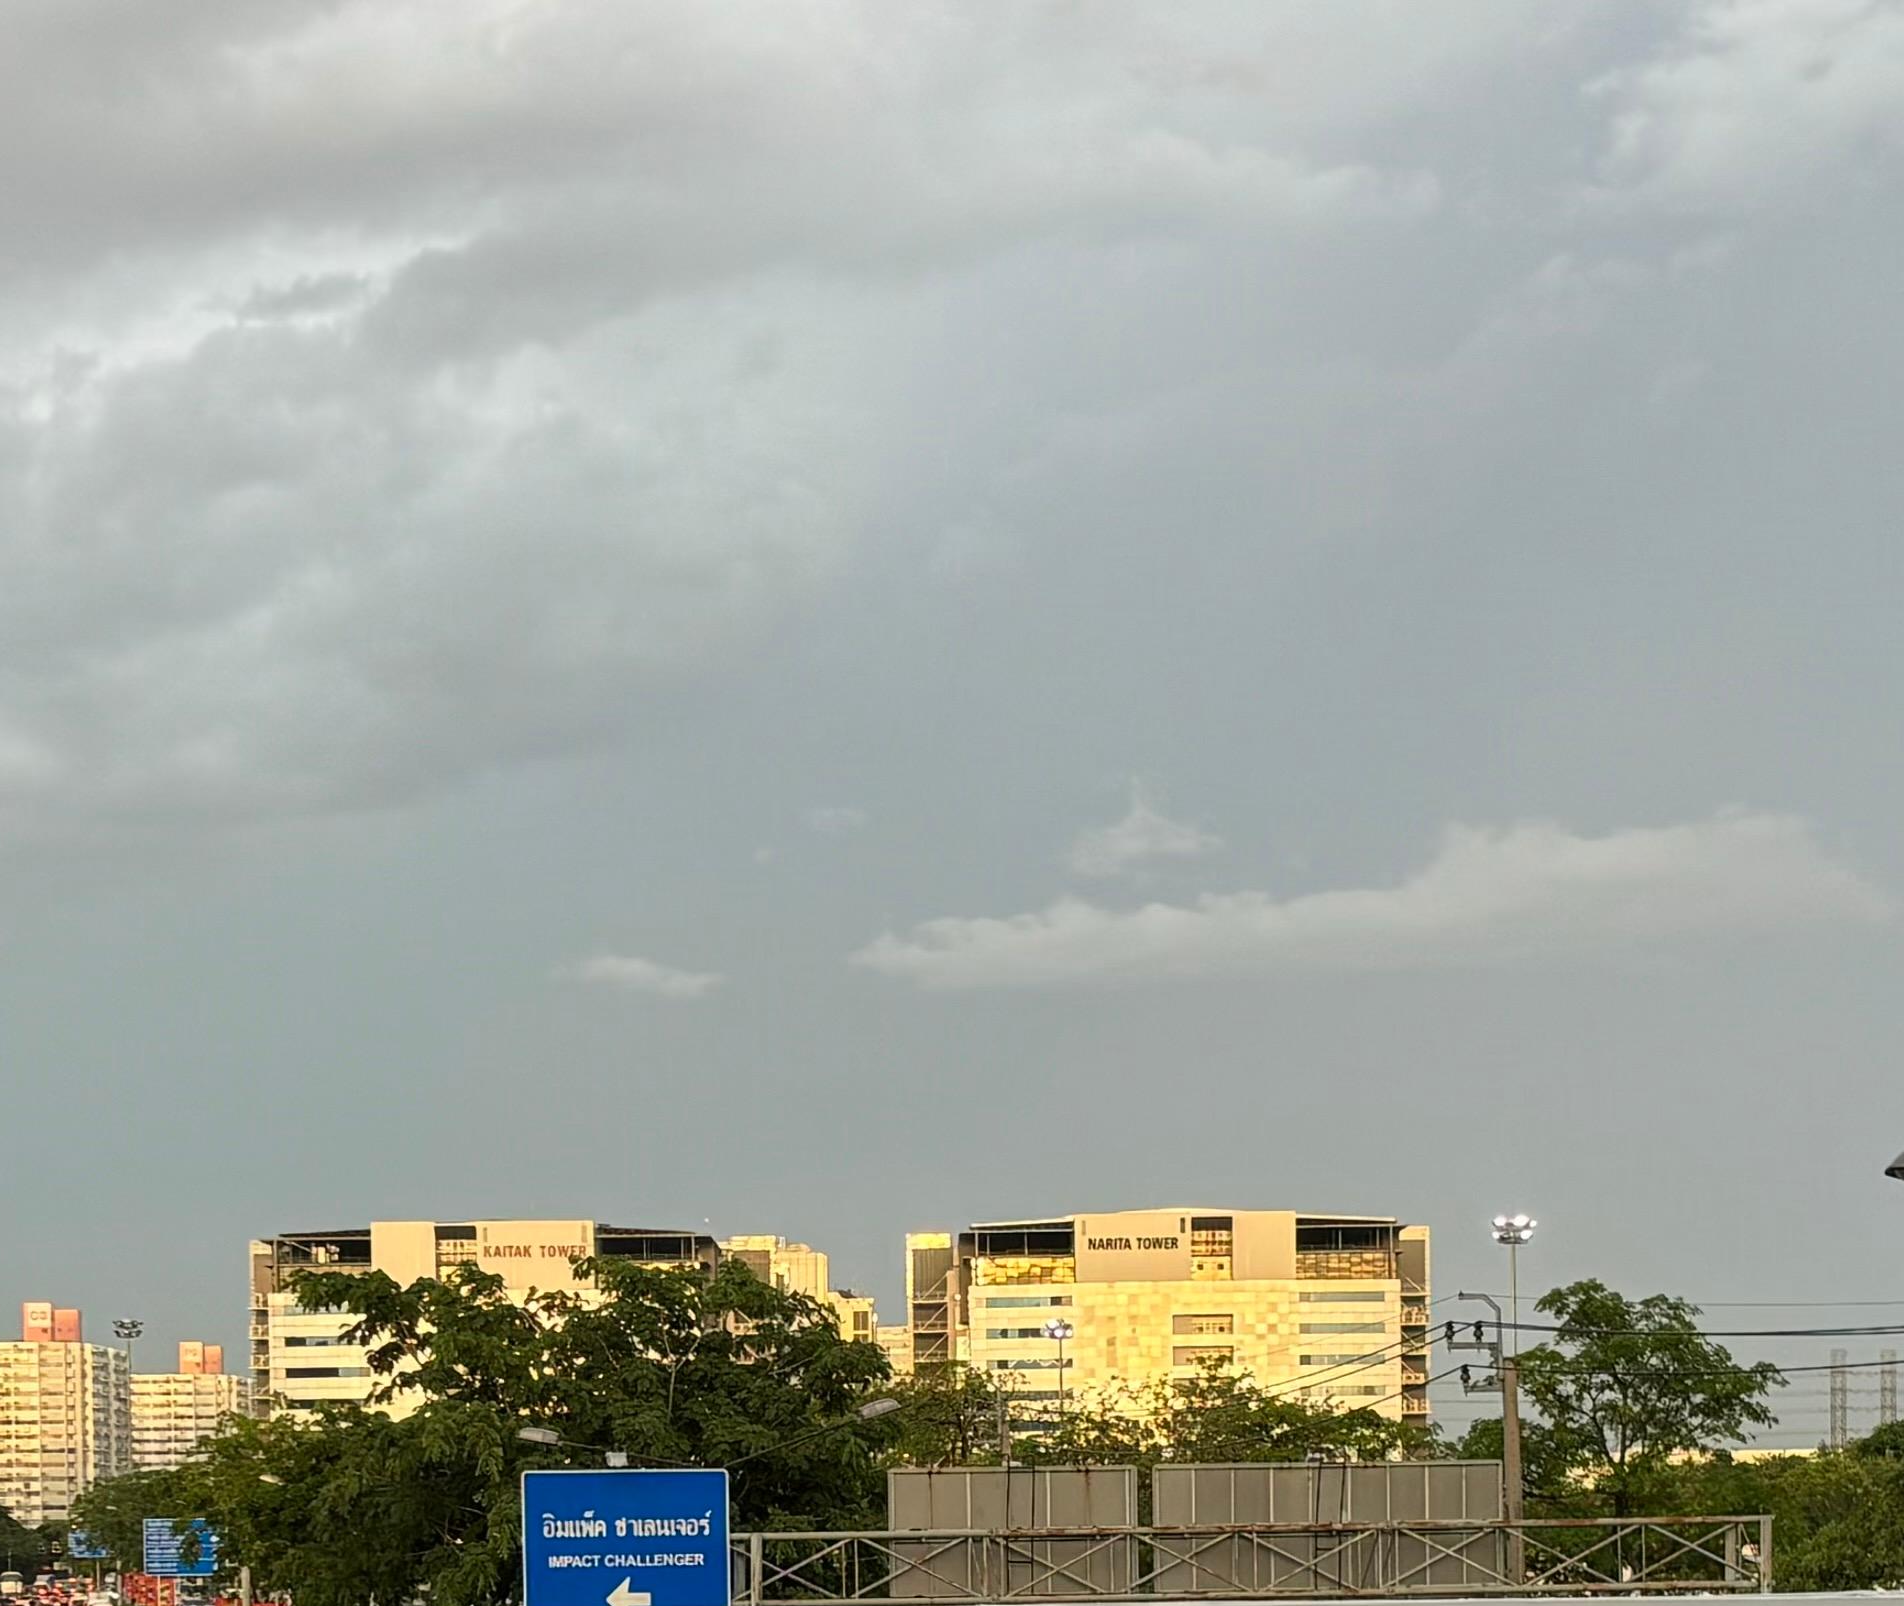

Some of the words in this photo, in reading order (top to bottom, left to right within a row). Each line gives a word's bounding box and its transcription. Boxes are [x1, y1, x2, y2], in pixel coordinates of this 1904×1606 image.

[1088, 1237, 1132, 1250] NARITA
[1137, 1237, 1179, 1250] TOWER
[483, 1245, 532, 1258] KAITAK
[539, 1245, 587, 1258] TOWER
[542, 1510, 607, 1538] อิมแพ็ค
[615, 1510, 712, 1537] ชาเลนเจอร์
[549, 1554, 600, 1568] IMPACT
[604, 1553, 704, 1567] CHALLENGER
